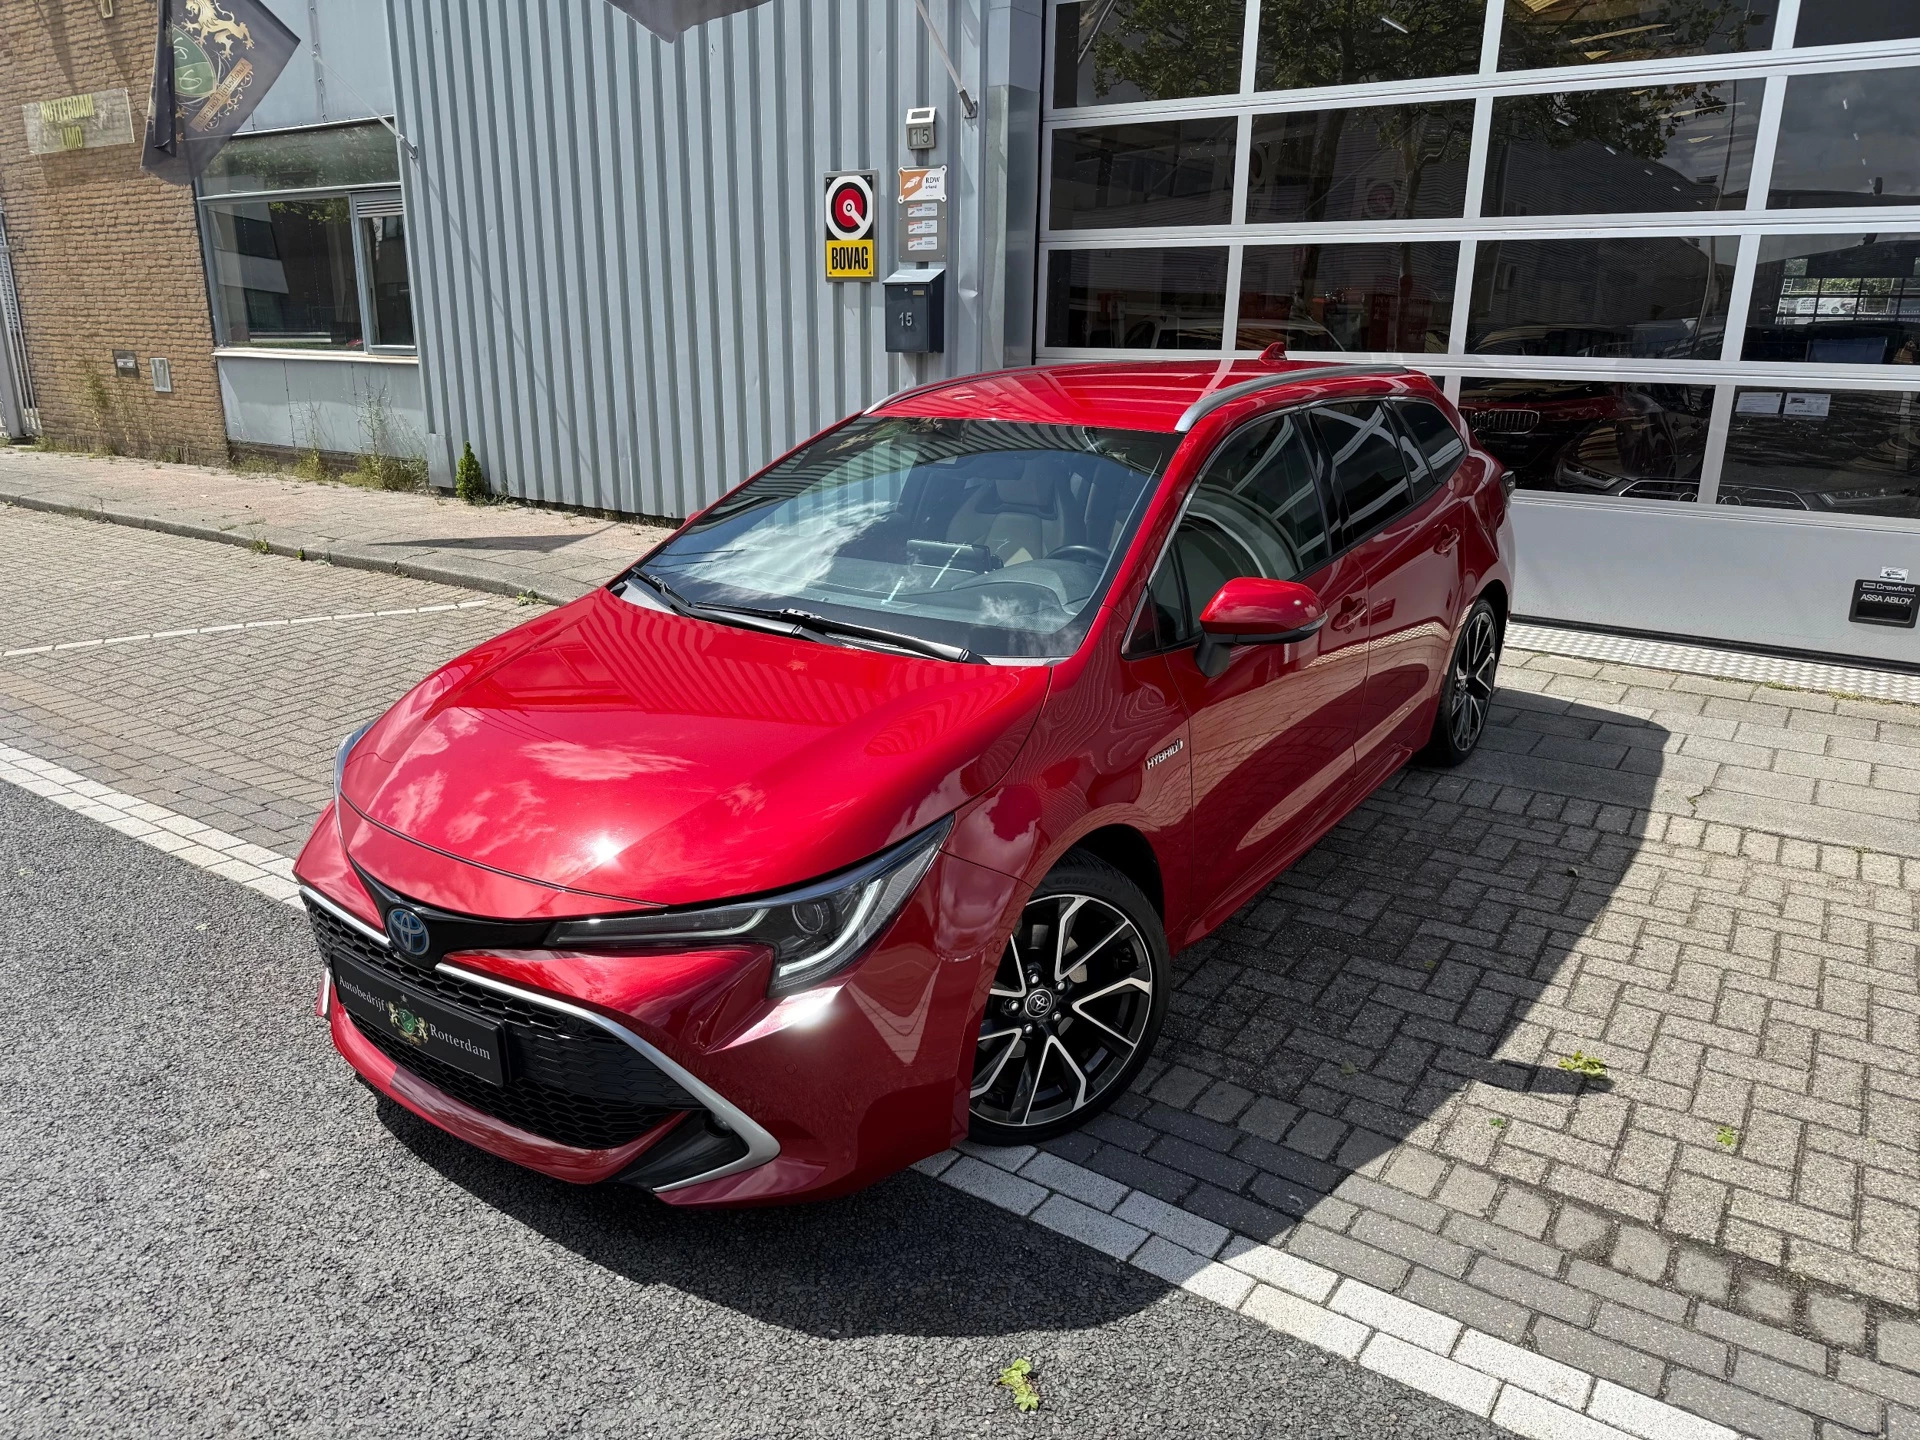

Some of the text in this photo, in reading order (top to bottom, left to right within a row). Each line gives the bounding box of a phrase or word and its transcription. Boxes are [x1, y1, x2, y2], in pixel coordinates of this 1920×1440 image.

[40, 93, 95, 122] ROTTERDAM
[60, 125, 83, 149] LIMO
[913, 128, 930, 145] 15
[925, 176, 941, 184] RDW
[831, 246, 869, 270] BOVAG
[899, 311, 913, 327] 15
[1876, 583, 1916, 593] Crawford
[1860, 593, 1913, 605] ASSA ABLOY
[1146, 743, 1180, 771] HYBRID
[339, 975, 491, 1061] Autobedrijf Rotterdam
